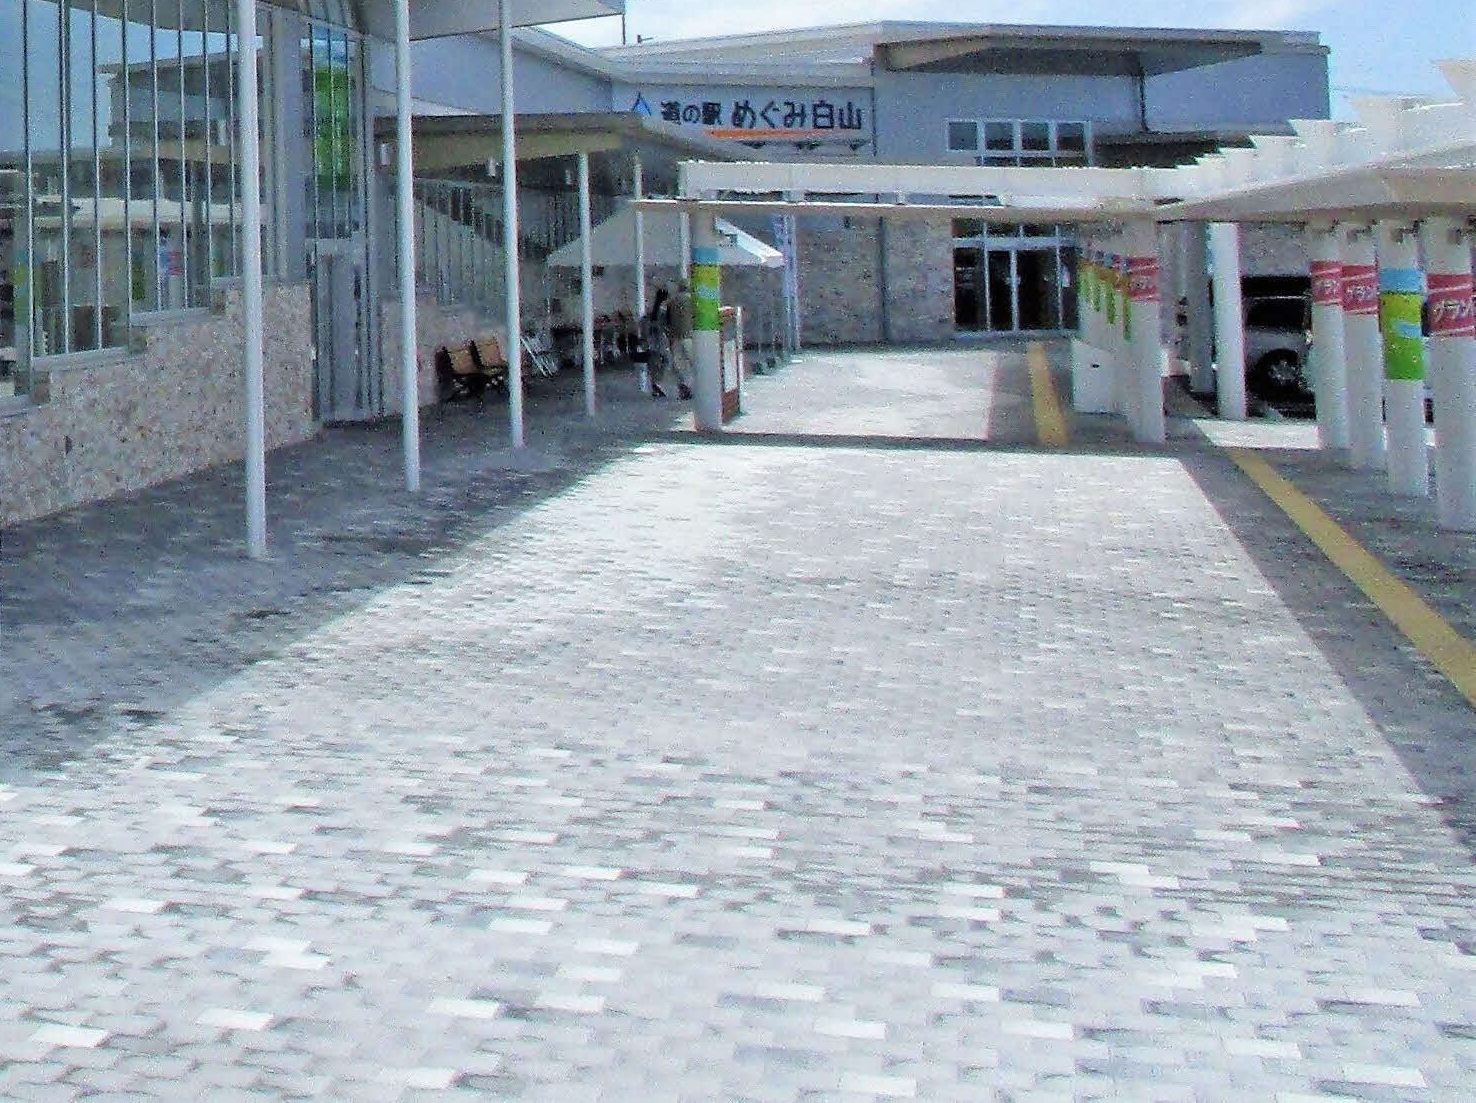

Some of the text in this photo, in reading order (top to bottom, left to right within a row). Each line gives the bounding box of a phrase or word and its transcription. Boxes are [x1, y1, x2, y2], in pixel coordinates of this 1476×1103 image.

[660, 99, 863, 130] 道の駅 めぐみ白山
